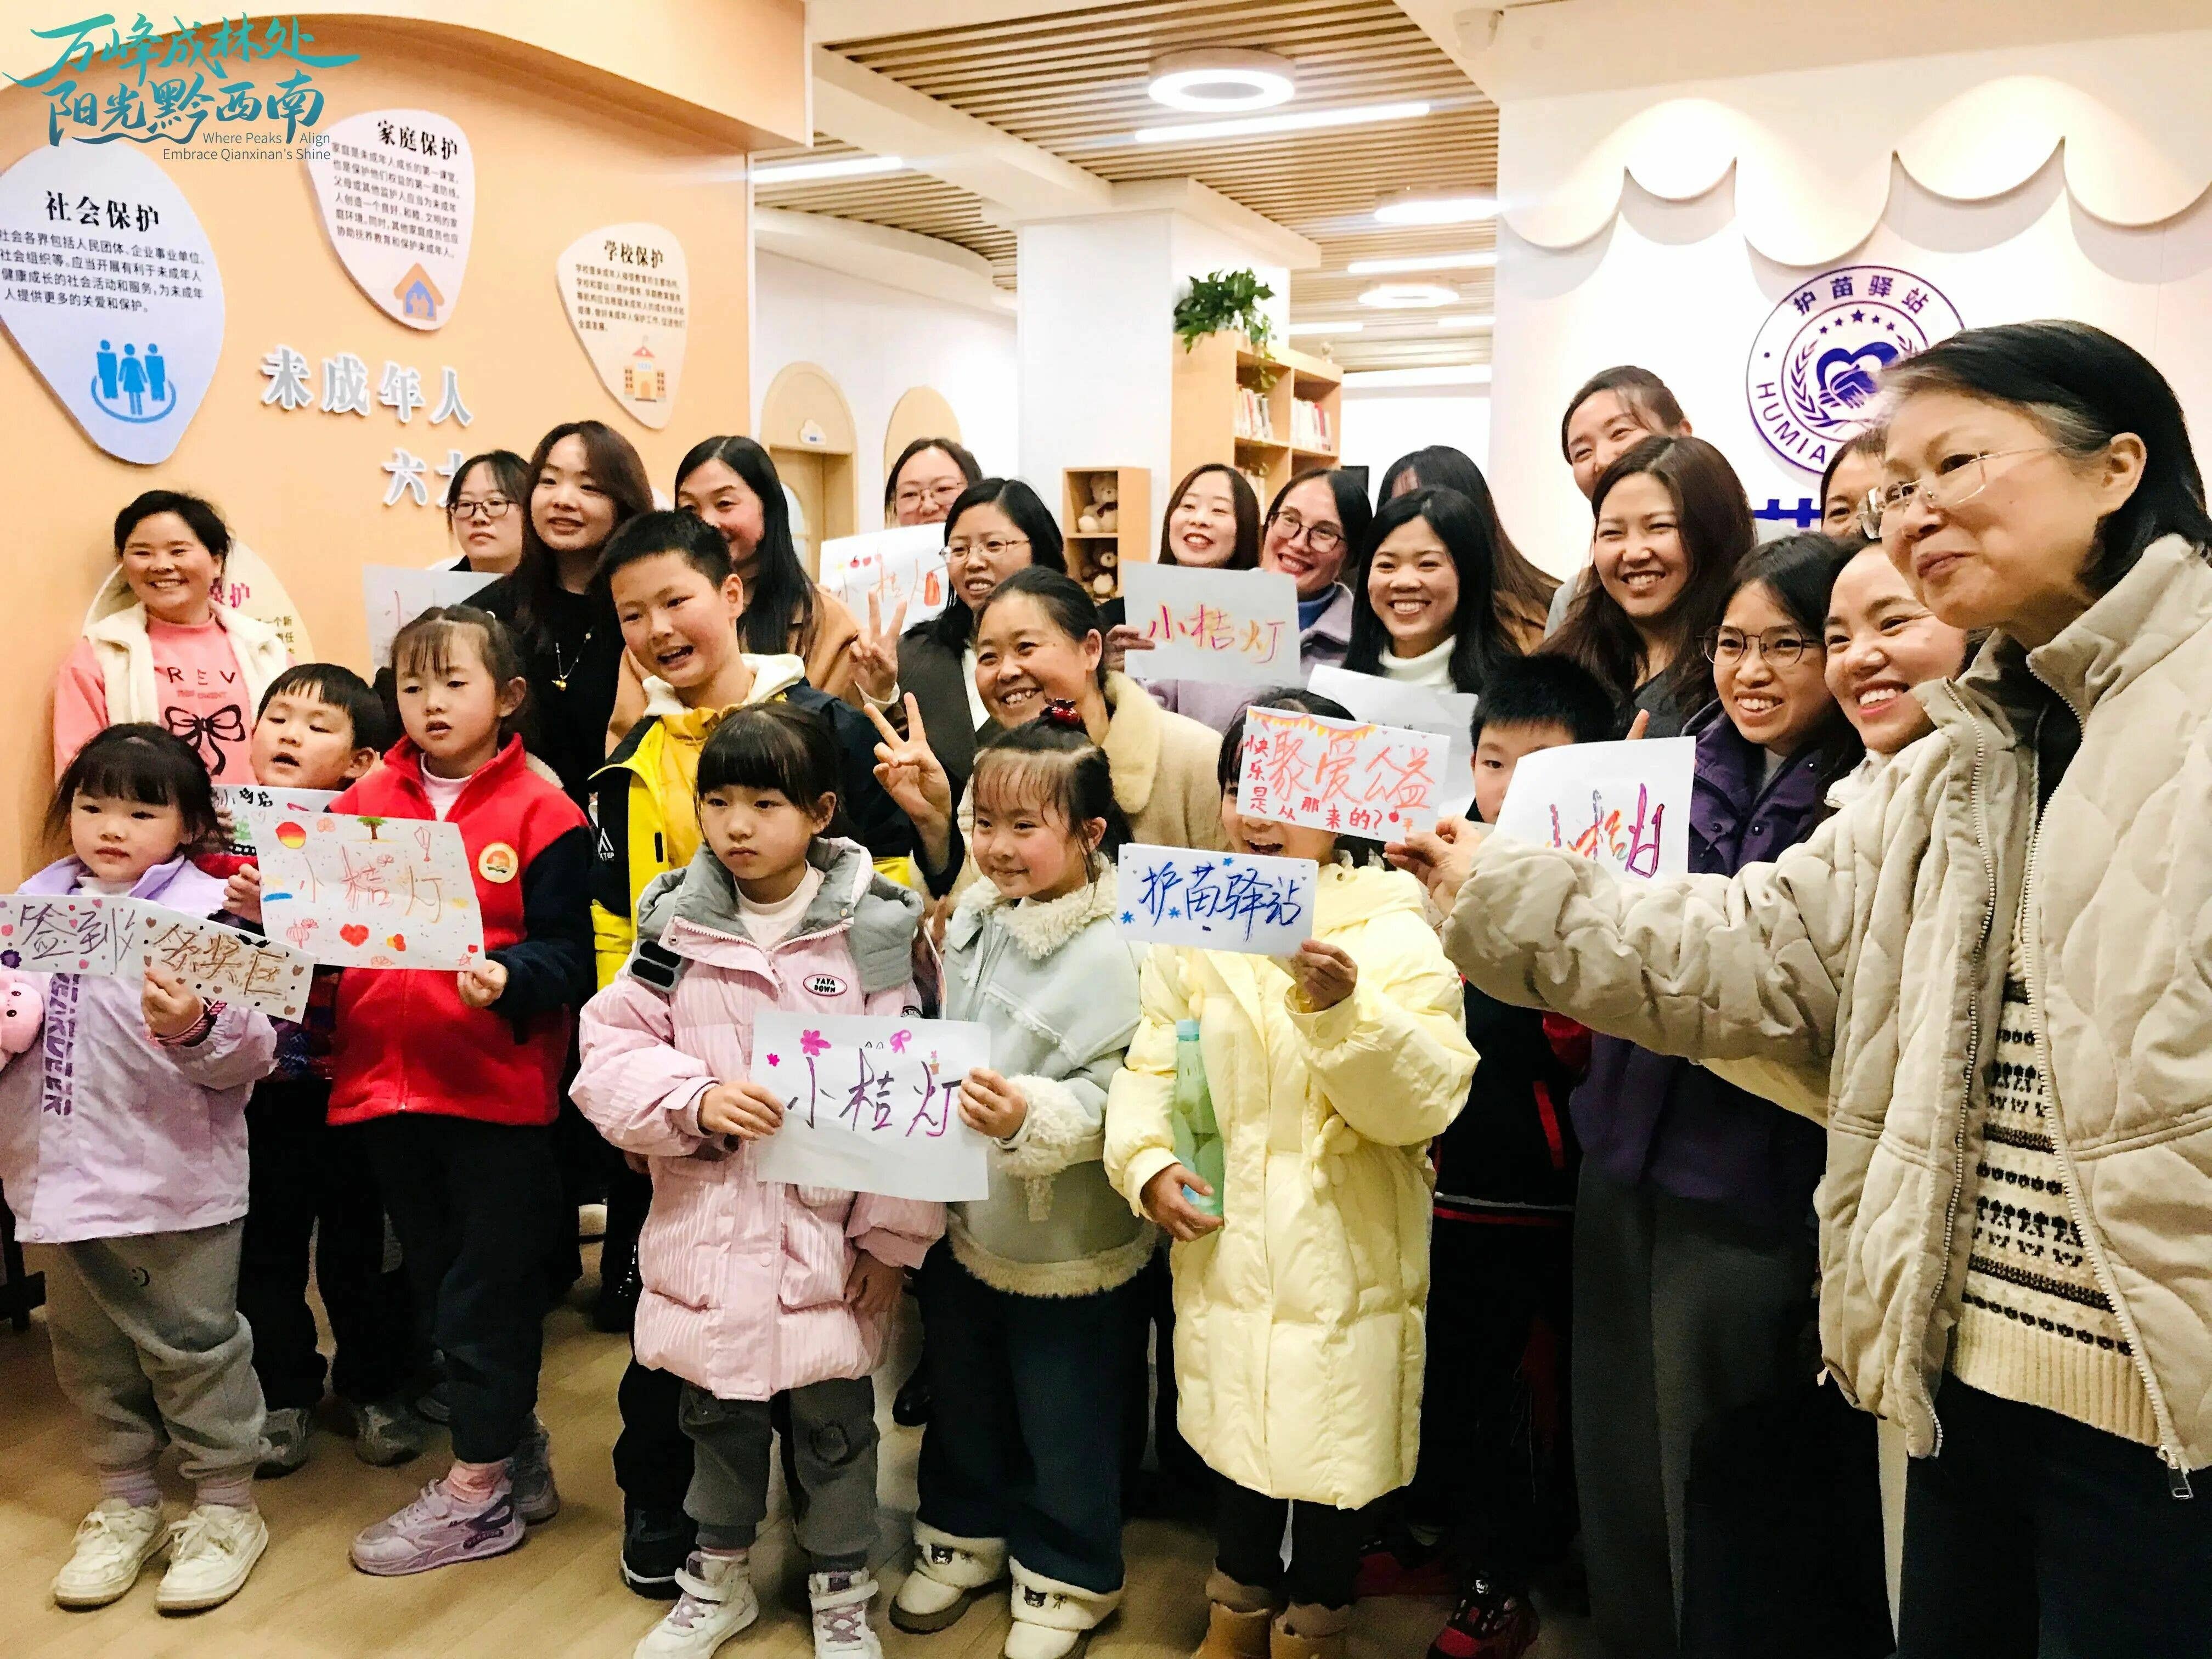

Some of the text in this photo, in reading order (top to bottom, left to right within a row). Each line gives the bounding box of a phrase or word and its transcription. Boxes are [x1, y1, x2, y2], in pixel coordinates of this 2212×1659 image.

[377, 119, 457, 160] 家庭保护
[46, 190, 159, 233] 社会保护
[604, 240, 663, 269] 学校保护
[1793, 275, 1930, 316] 护苗驿站
[260, 344, 474, 427] 未成年人
[1148, 603, 1286, 665] 小桔灯
[1268, 730, 1435, 810] 聚爱公益
[300, 844, 443, 924] 小桔灯
[1138, 861, 1302, 943] 护苗驿站
[816, 978, 835, 986] YAYA
[786, 1047, 962, 1137] 小桔灯
